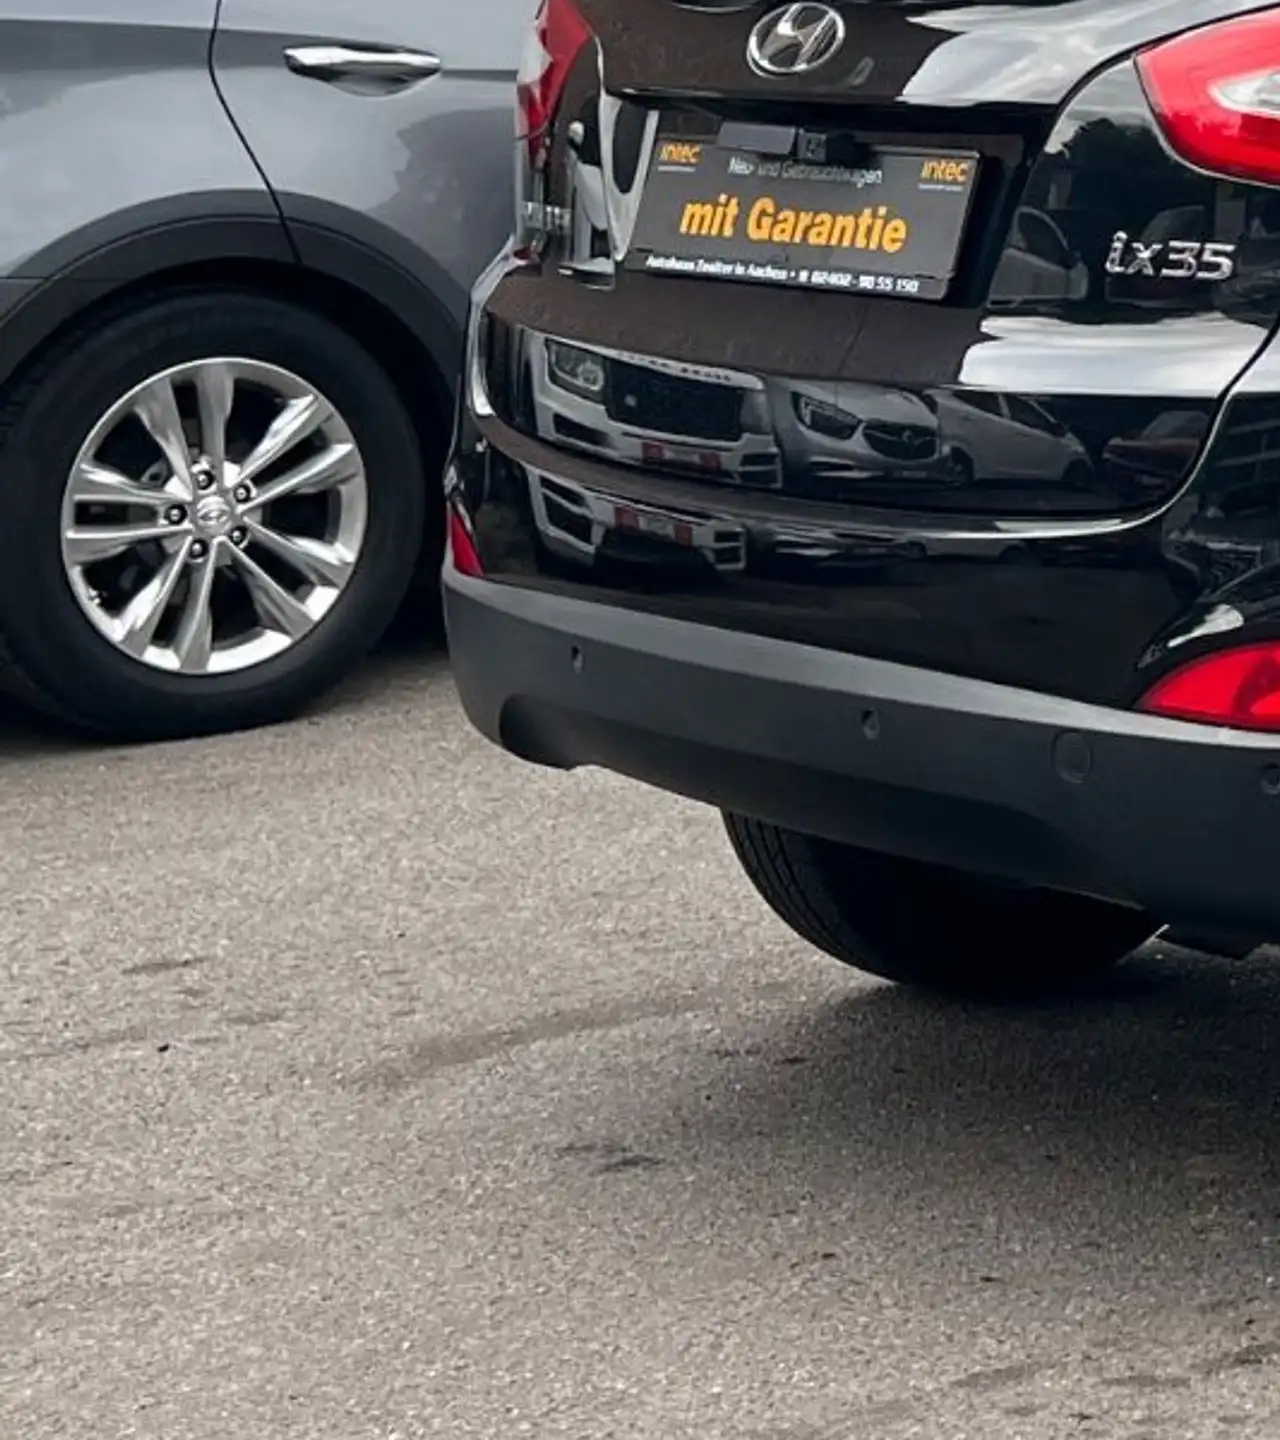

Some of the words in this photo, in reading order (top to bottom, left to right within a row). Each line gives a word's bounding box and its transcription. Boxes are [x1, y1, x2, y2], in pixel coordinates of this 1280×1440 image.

[920, 159, 969, 183] intec
[679, 193, 740, 238] mit
[747, 196, 908, 254] Garantie
[1104, 230, 1237, 280] ix35
